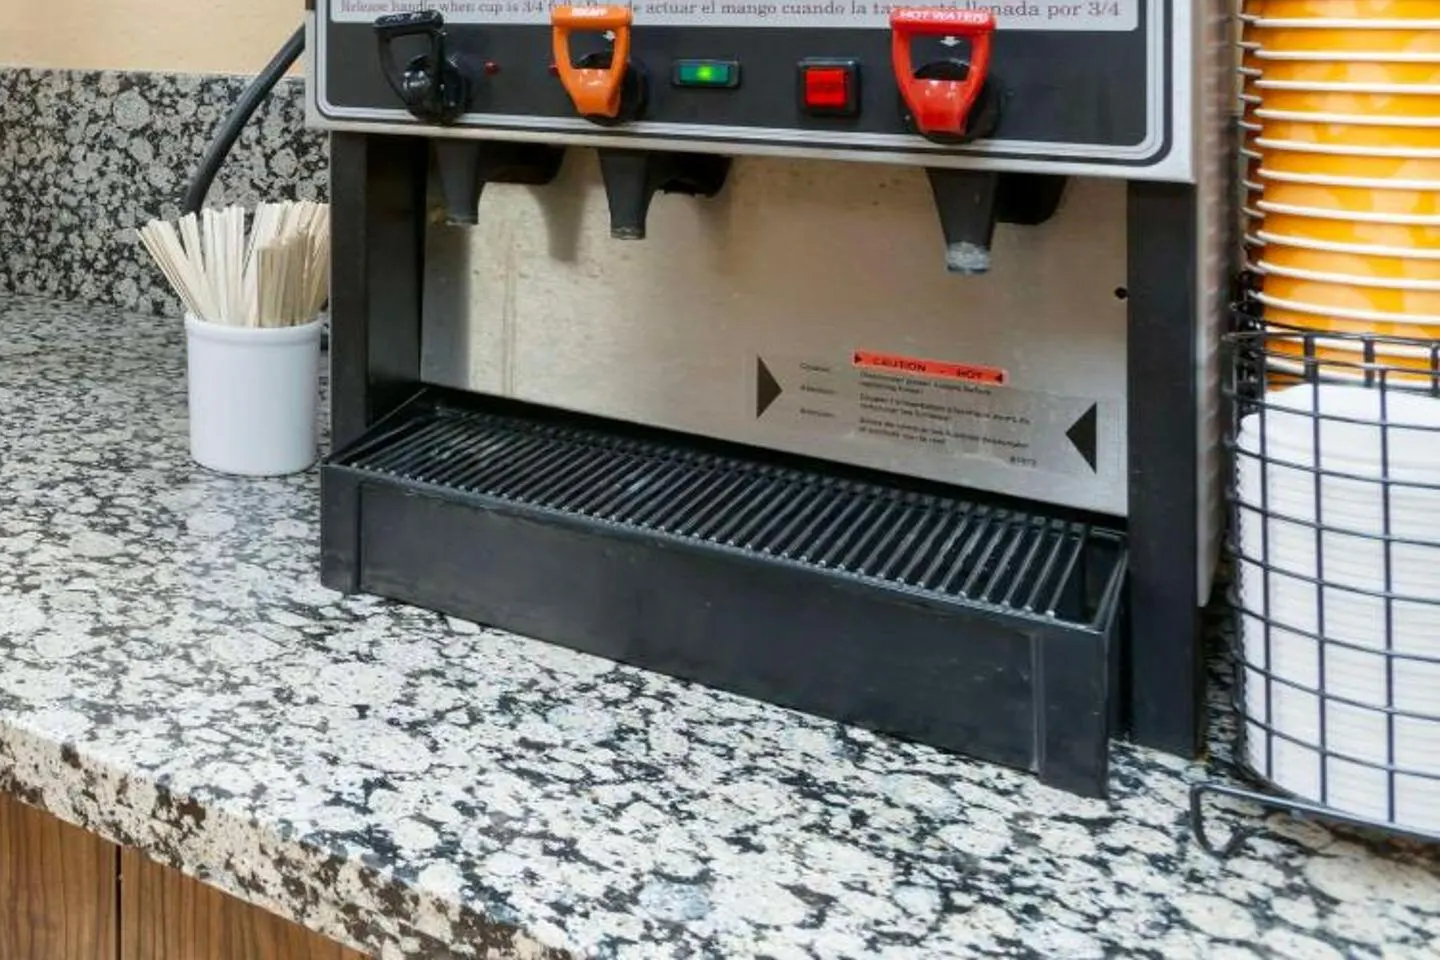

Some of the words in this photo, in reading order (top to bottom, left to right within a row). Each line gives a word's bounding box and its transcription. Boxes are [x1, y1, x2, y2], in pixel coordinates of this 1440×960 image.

[478, 3, 503, 17] cup
[523, 0, 544, 14] 3/4
[646, 0, 697, 15] actuar
[701, 0, 716, 15] el
[721, 3, 777, 18] mango
[781, 0, 846, 15] cuando
[851, 0, 868, 15] la
[1047, 4, 1082, 20] por
[1088, 0, 1120, 17] 3/4
